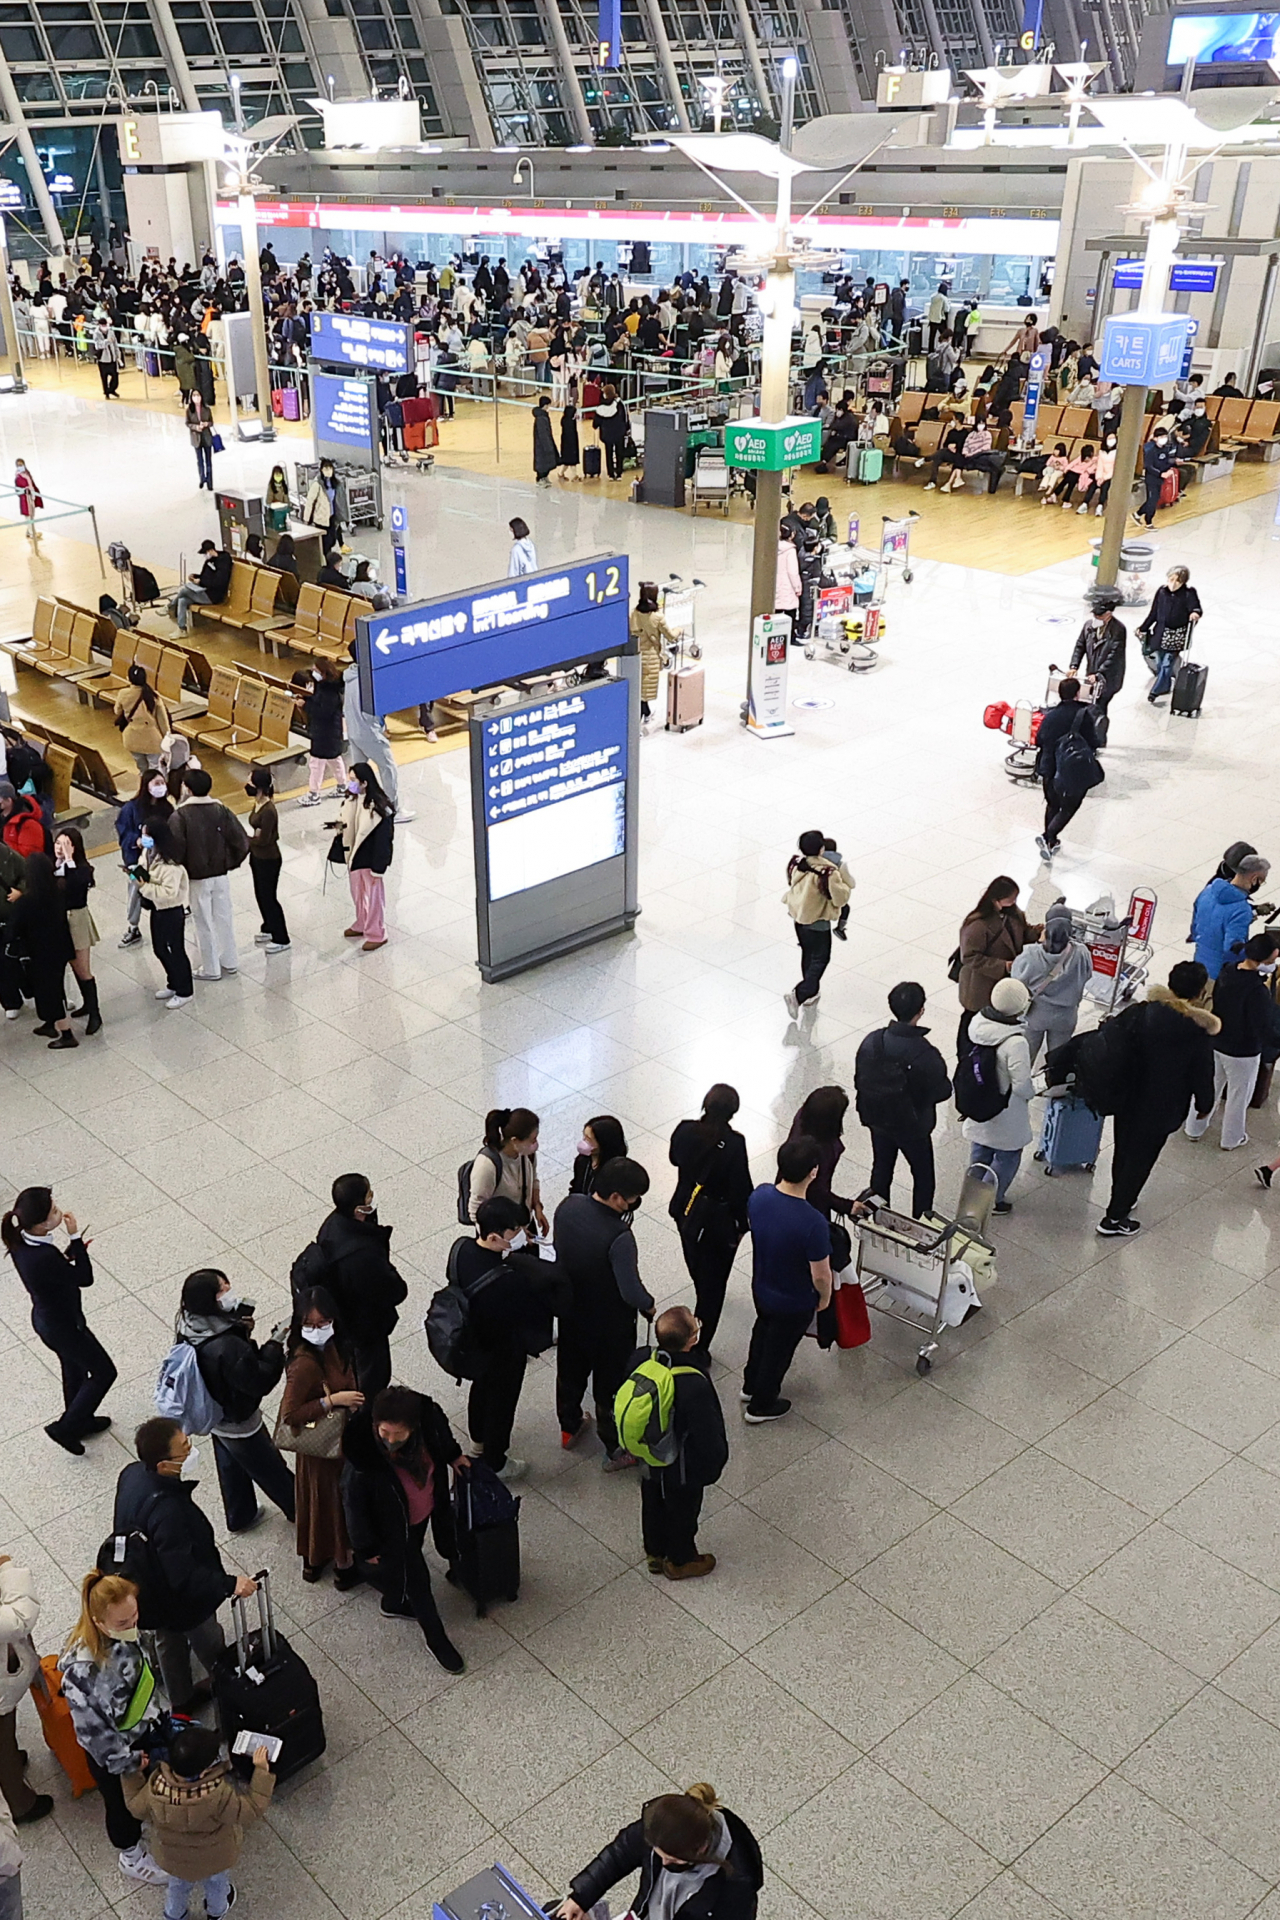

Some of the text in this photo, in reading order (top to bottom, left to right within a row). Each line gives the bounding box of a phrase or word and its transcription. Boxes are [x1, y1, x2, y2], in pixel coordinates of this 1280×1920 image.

[1021, 30, 1034, 50] G
[599, 41, 610, 66] F
[886, 75, 901, 103] F
[124, 121, 141, 159] E
[858, 206, 873, 216] E33
[943, 207, 959, 217] E34
[989, 208, 1006, 218] E35
[1029, 209, 1047, 219] E36
[313, 316, 321, 332] 3
[1115, 335, 1144, 355] 카트
[1111, 356, 1142, 369] CARTS
[747, 438, 766, 450] AED
[796, 433, 812, 445] AED
[770, 635, 785, 644] AED
